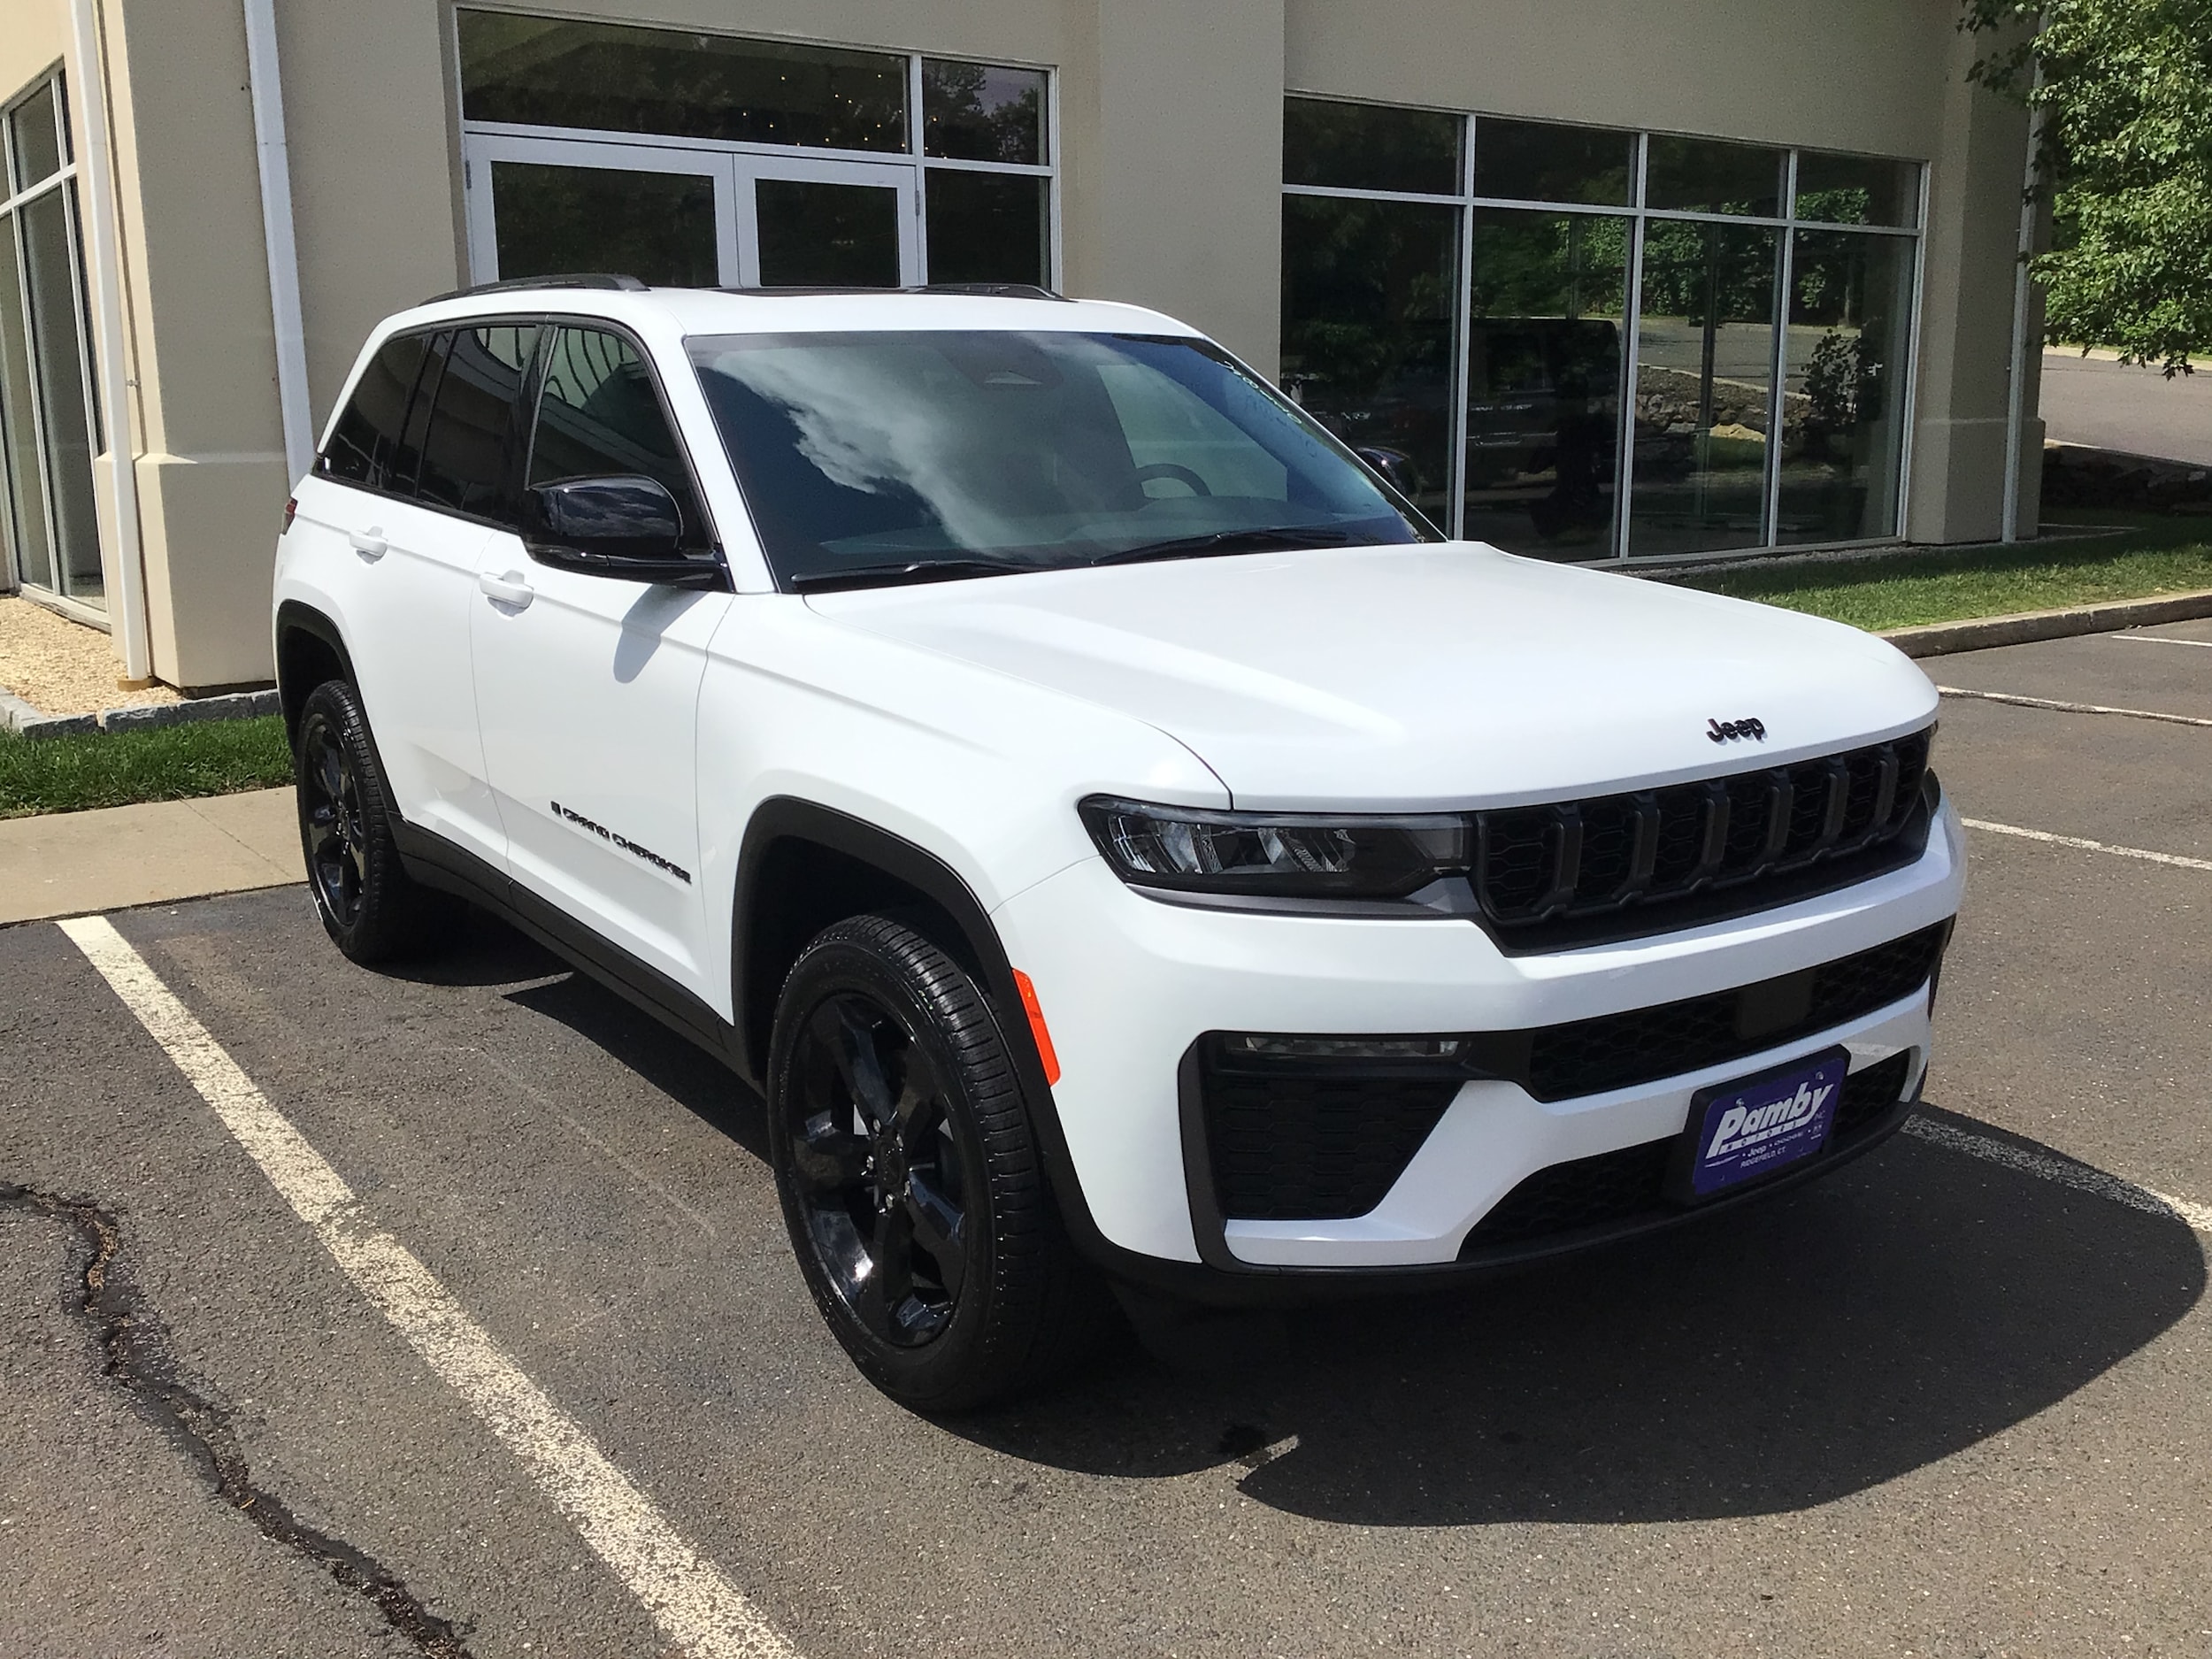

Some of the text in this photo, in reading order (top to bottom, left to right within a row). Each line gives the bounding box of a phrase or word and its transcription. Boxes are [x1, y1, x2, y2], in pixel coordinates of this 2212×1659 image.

[1706, 718, 1765, 742] Jeep
[563, 807, 692, 885] GRAND CHEROKEE
[1705, 1081, 1834, 1159] Pamby
